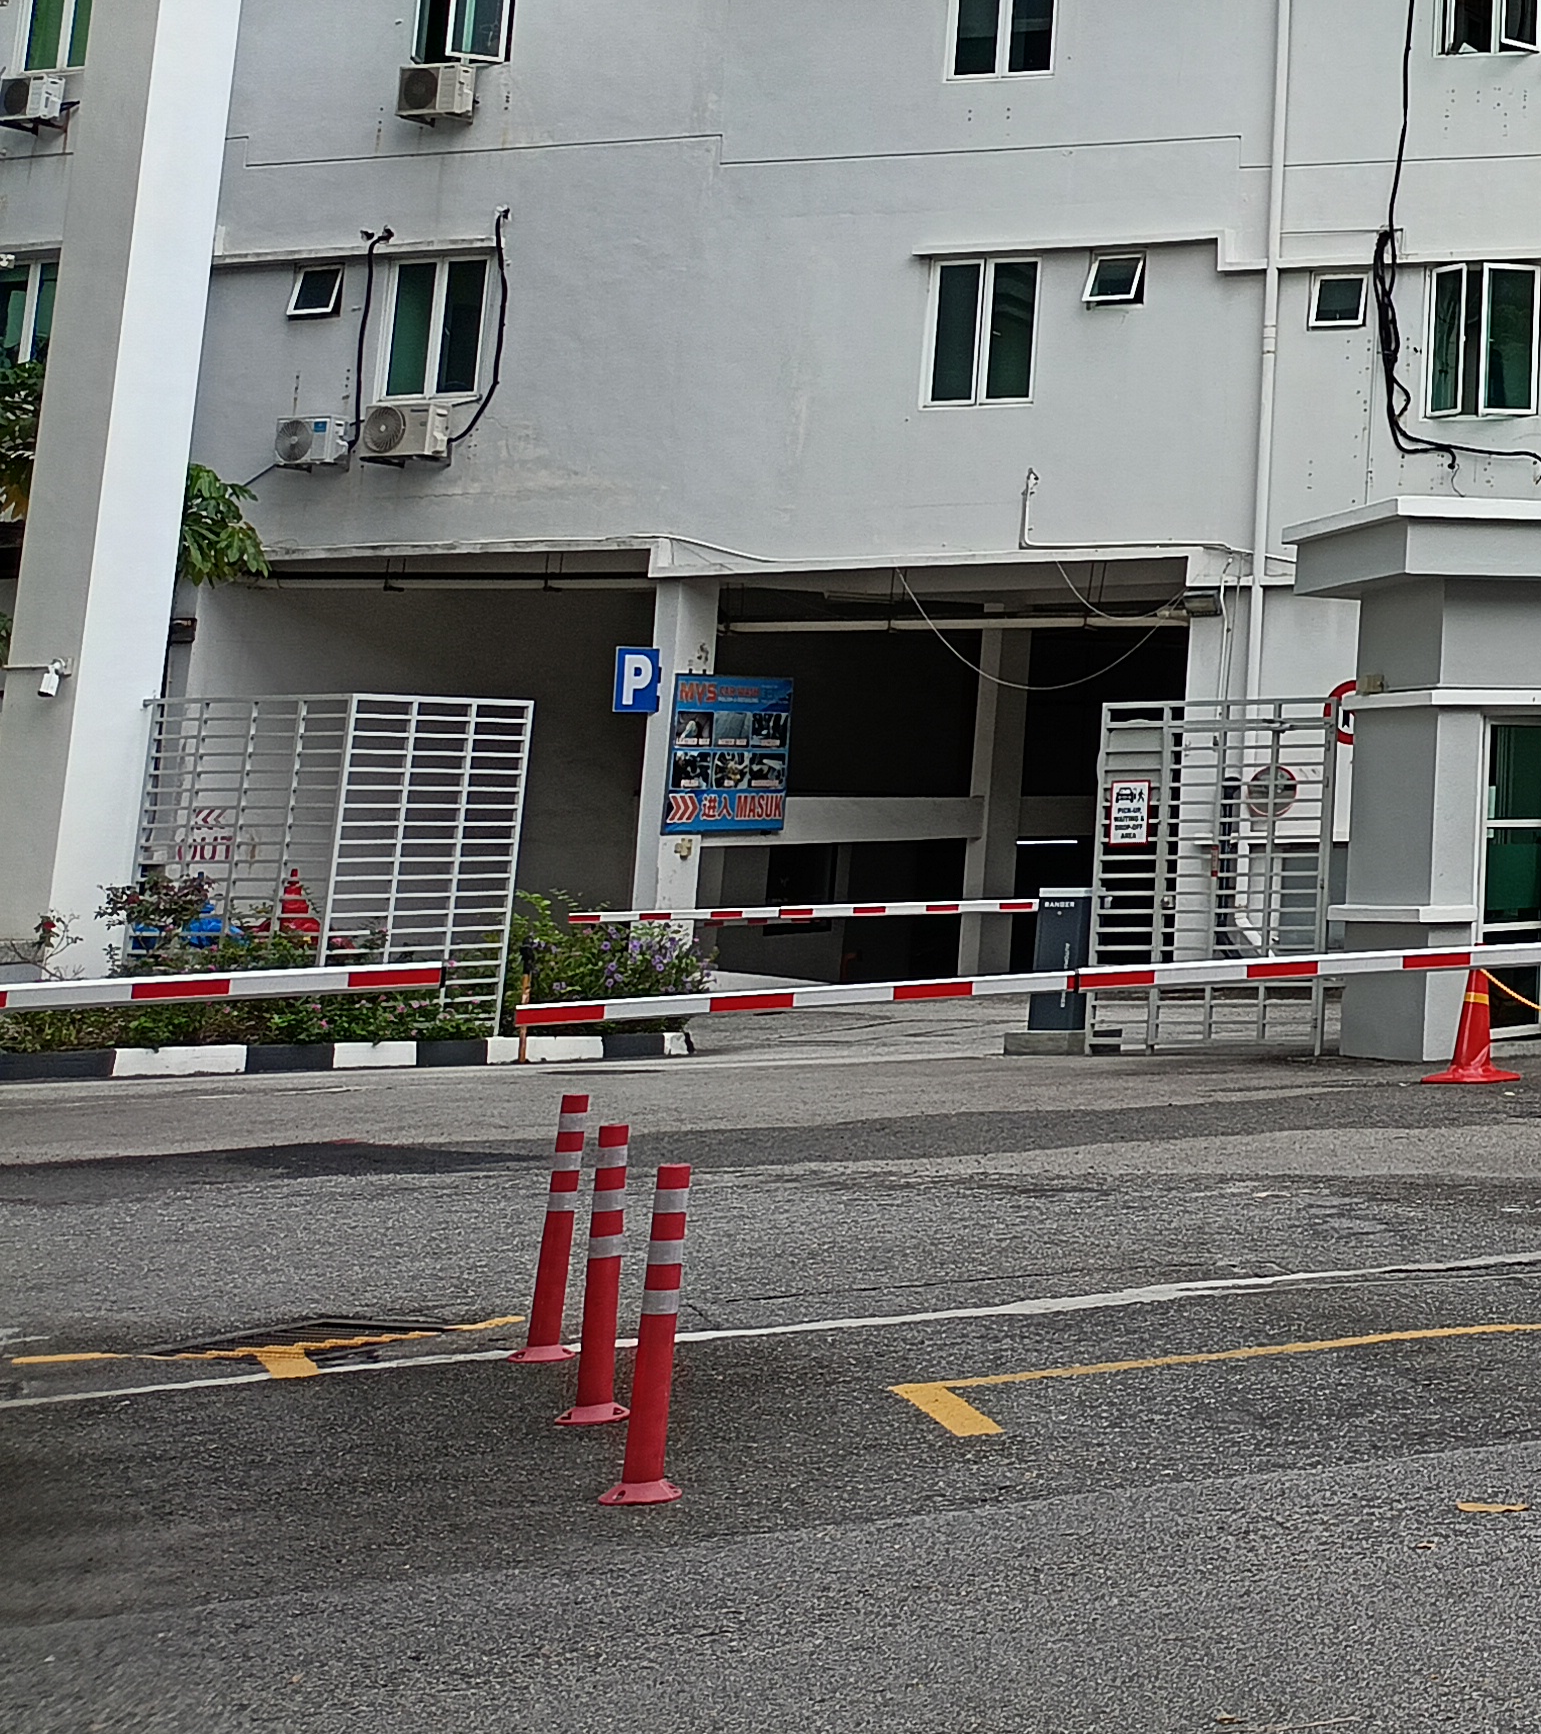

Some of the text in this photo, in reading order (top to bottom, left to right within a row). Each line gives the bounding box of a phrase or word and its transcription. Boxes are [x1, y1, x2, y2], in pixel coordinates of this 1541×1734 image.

[621, 653, 653, 706] P
[679, 680, 718, 706] MVS
[701, 794, 733, 820] 进入
[735, 794, 784, 820] MASUK
